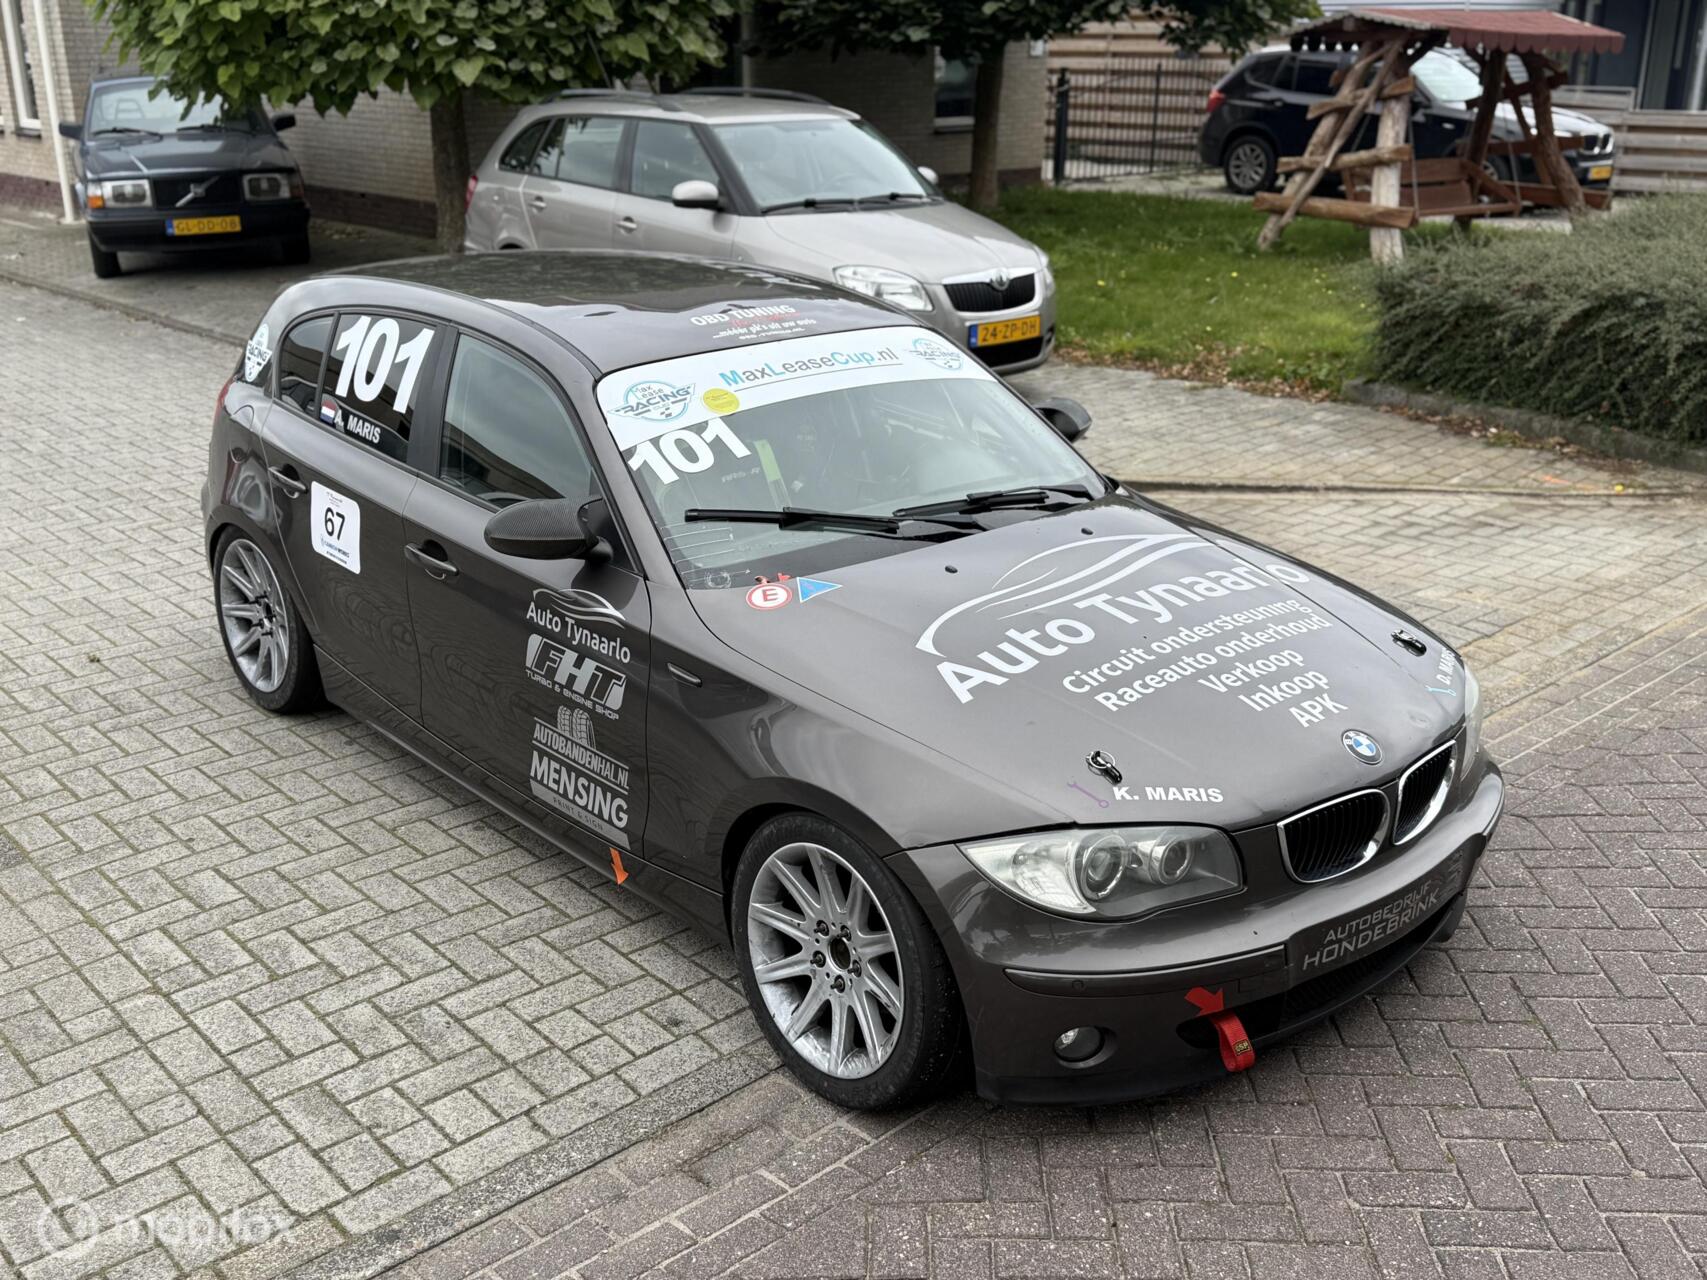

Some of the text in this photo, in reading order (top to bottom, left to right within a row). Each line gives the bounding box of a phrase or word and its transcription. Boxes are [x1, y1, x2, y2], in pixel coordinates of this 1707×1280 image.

[690, 312, 729, 326] OBD
[731, 304, 797, 320] TUNING
[981, 321, 1037, 342] 24-ZP-DH
[335, 315, 435, 414] 101
[718, 347, 900, 391] MaxLeaseCup.nl
[620, 387, 690, 414] RACING
[334, 410, 381, 444] A. MARIS
[627, 417, 752, 485] 101
[325, 507, 345, 541] 67
[762, 588, 778, 602] E
[526, 602, 631, 664] Auto Tynaarlo
[935, 556, 1310, 705] Auto Tynaarlo
[1062, 596, 1313, 696] Circuit ondersteuning
[532, 636, 627, 711] FHT
[1094, 613, 1333, 713] Raceauto onderhoud
[1198, 646, 1305, 695] Verkoop
[526, 669, 619, 721] TURBO & ENGINE SHOP
[1238, 669, 1329, 713] Inkoop
[1288, 694, 1348, 729] APK
[533, 722, 629, 789] AUTOBANDENHAL.NL
[530, 750, 629, 829] MENSING
[552, 796, 577, 816] PRINT
[584, 814, 604, 830] SIGN
[1113, 785, 1224, 803] K. MARIS
[1302, 887, 1438, 971] HONDEBRINK
[1324, 882, 1432, 943] AUTOBEDRIJF
